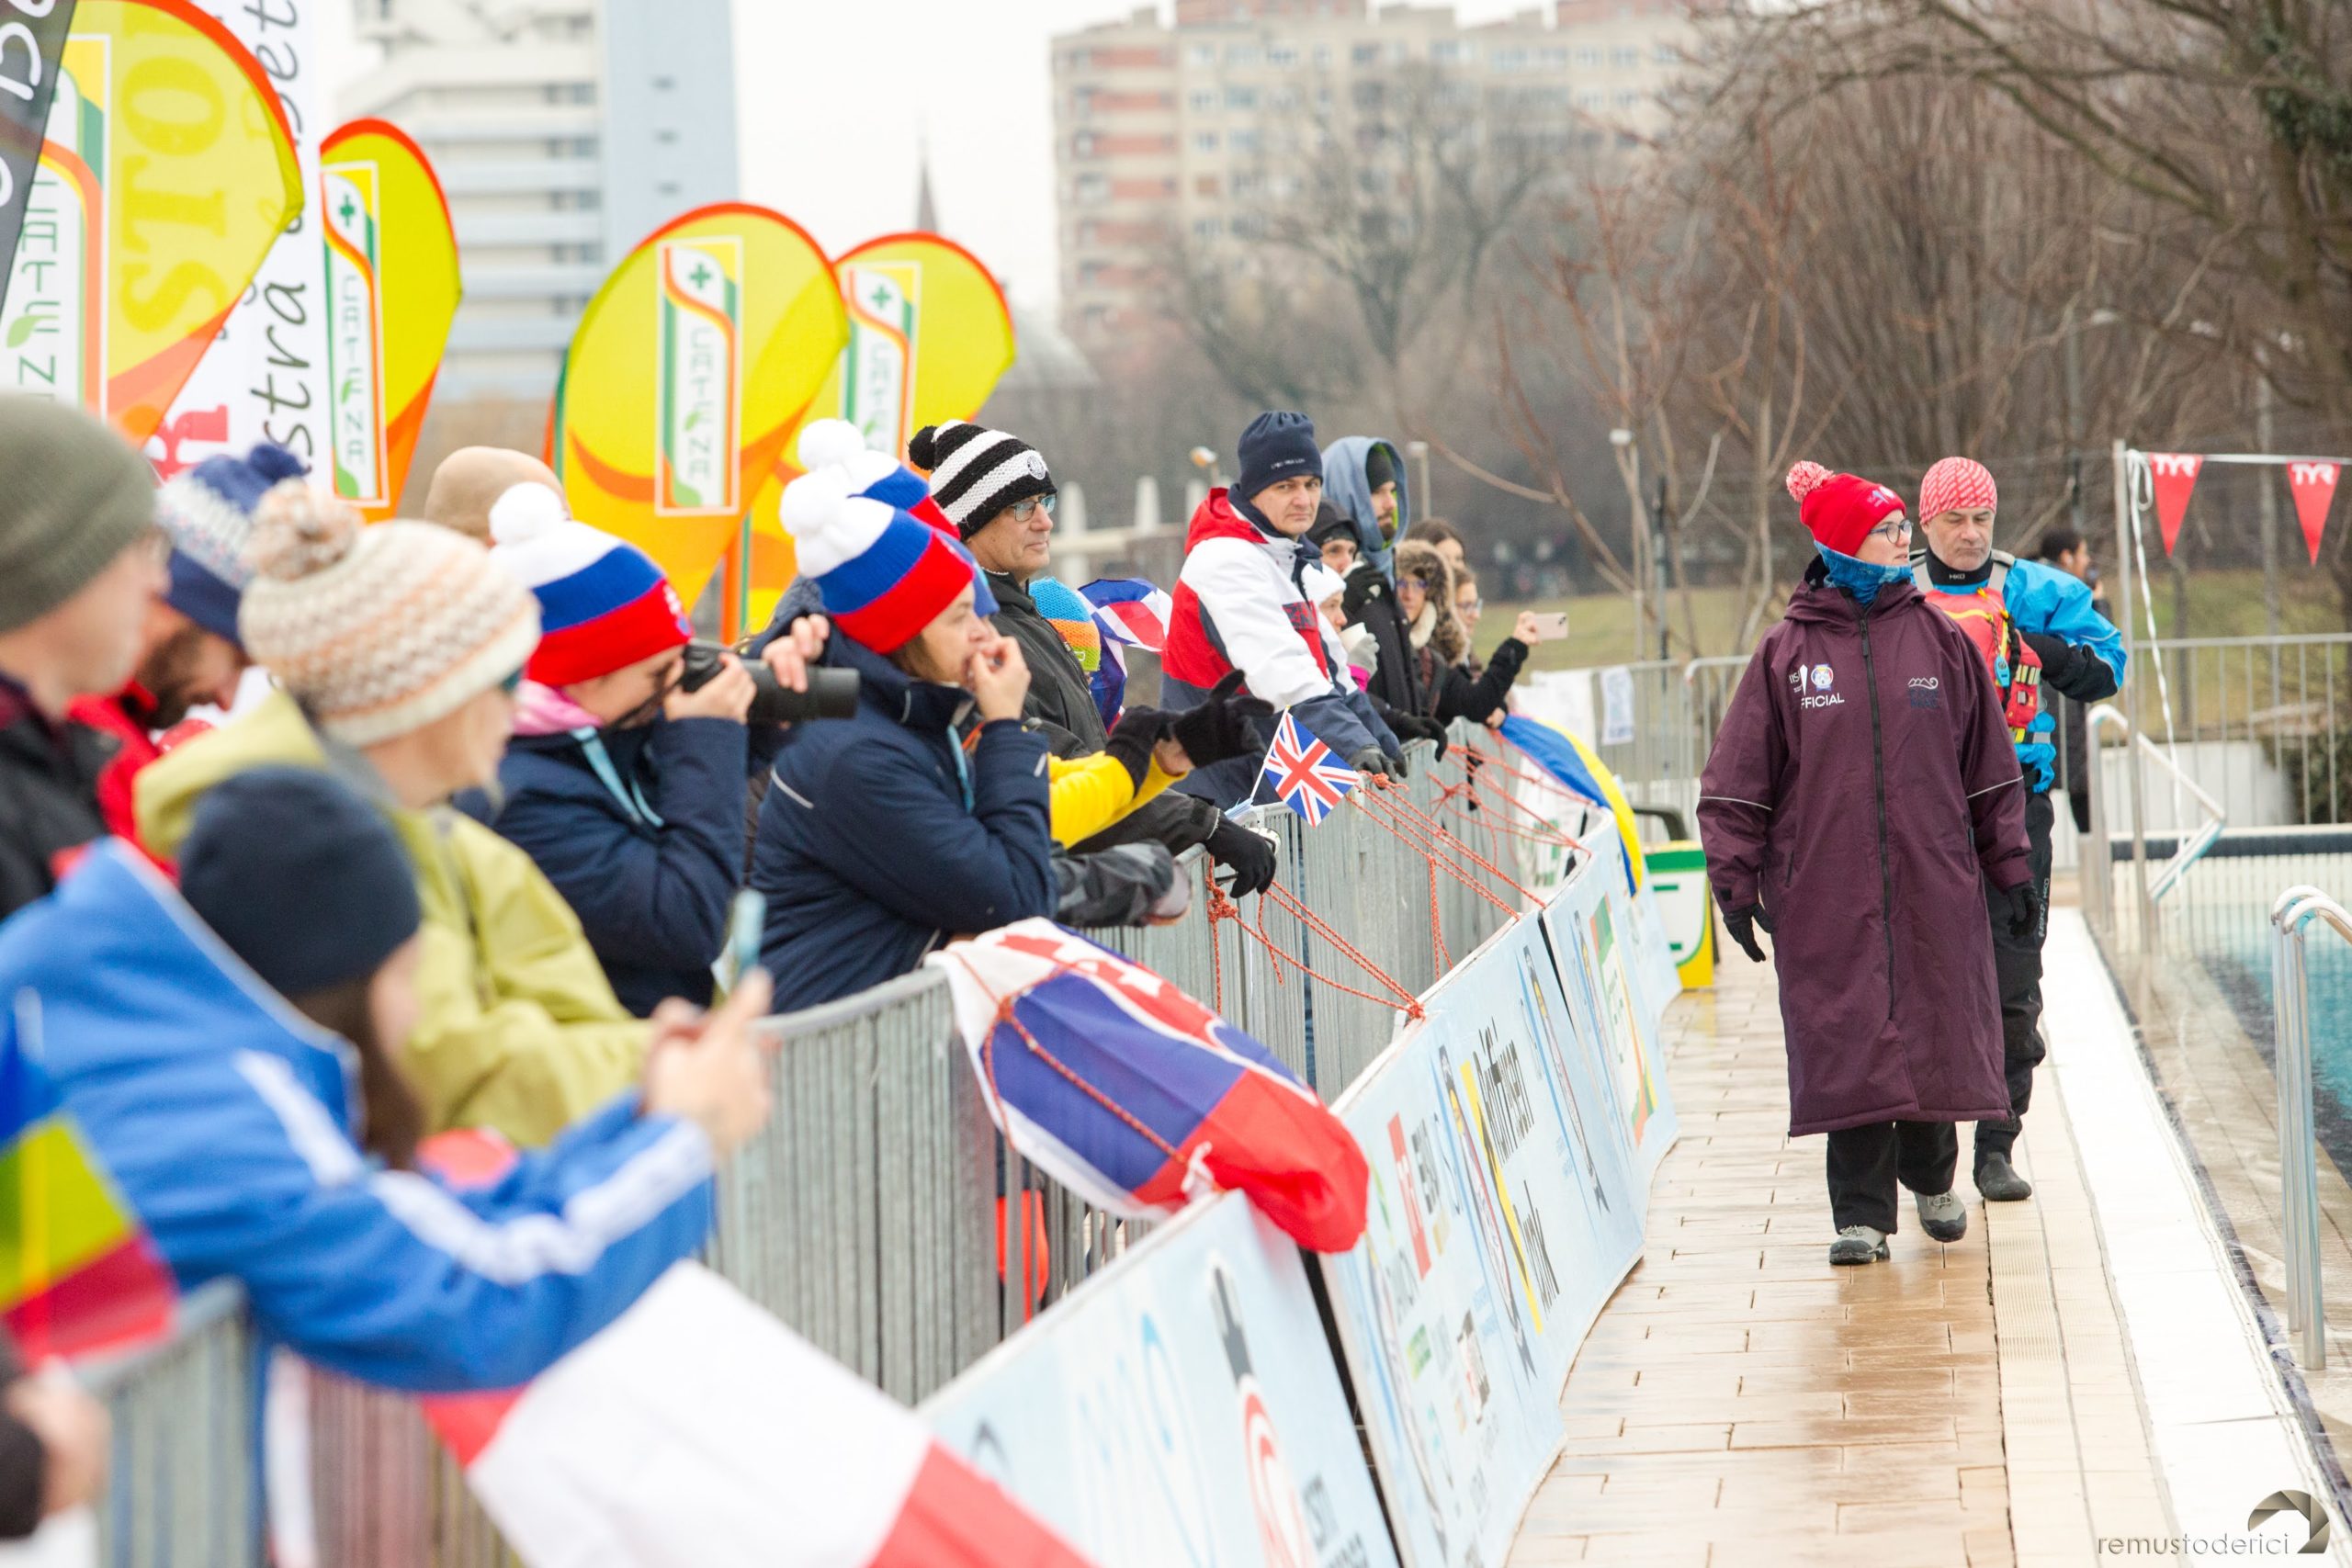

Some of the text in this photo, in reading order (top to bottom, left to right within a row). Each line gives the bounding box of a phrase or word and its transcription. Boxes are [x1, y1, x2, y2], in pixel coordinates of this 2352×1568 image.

[341, 275, 365, 465] CATENA
[687, 325, 716, 479] CATENA
[2153, 453, 2196, 478] TYR
[2291, 463, 2335, 485] TYR
[1801, 693, 1845, 709] FFICIAL
